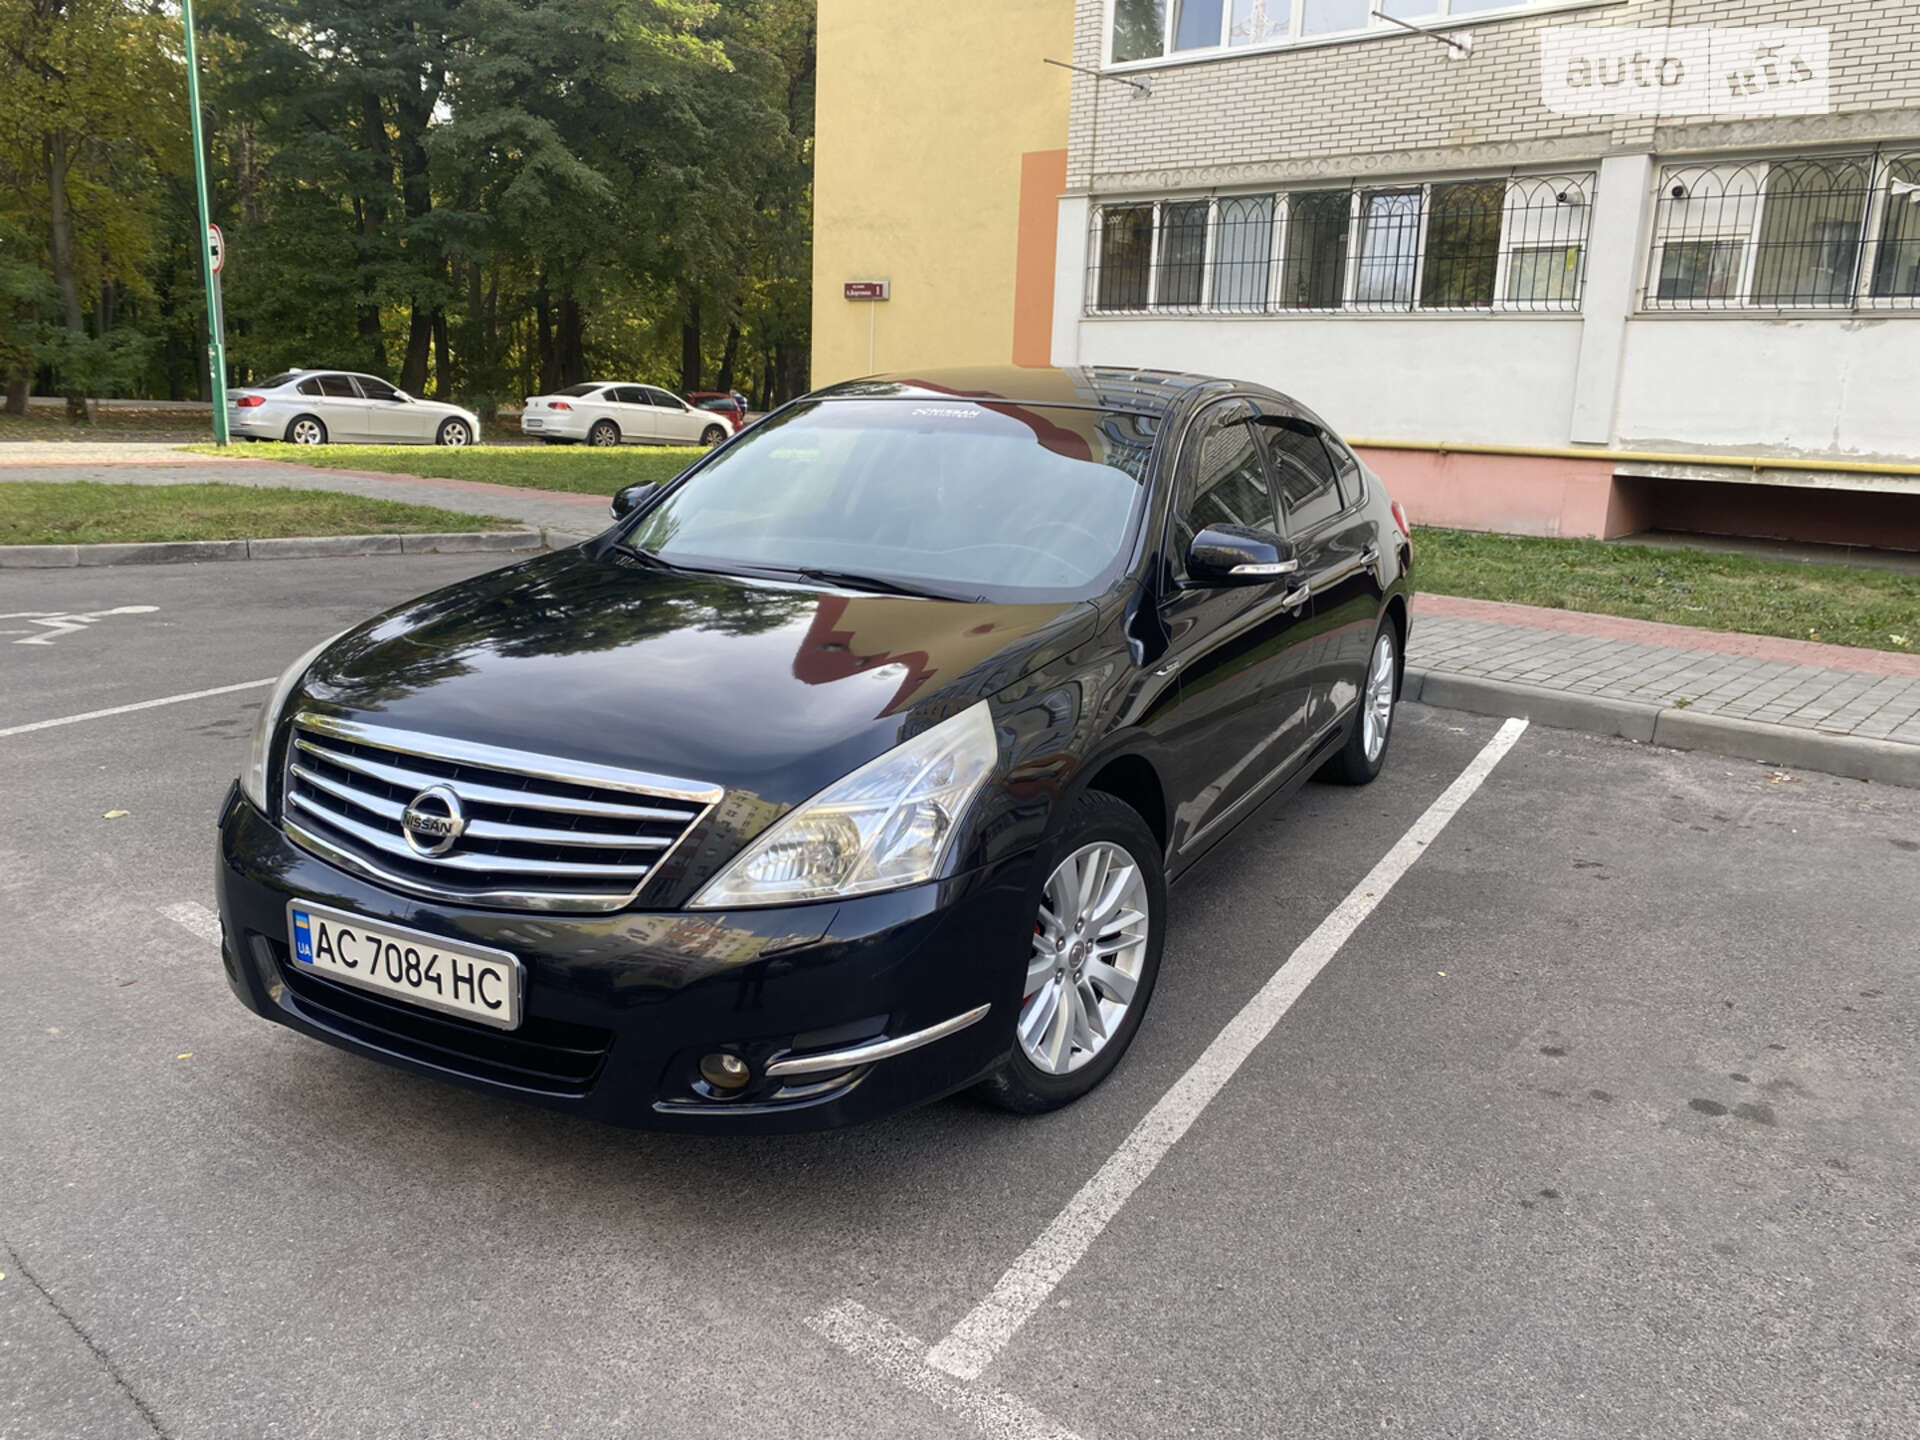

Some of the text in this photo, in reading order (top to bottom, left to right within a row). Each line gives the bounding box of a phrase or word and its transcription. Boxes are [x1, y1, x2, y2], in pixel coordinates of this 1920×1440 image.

[403, 811, 453, 833] NISSAN
[297, 941, 312, 957] UA
[315, 922, 502, 1009] AC 7084 HC
